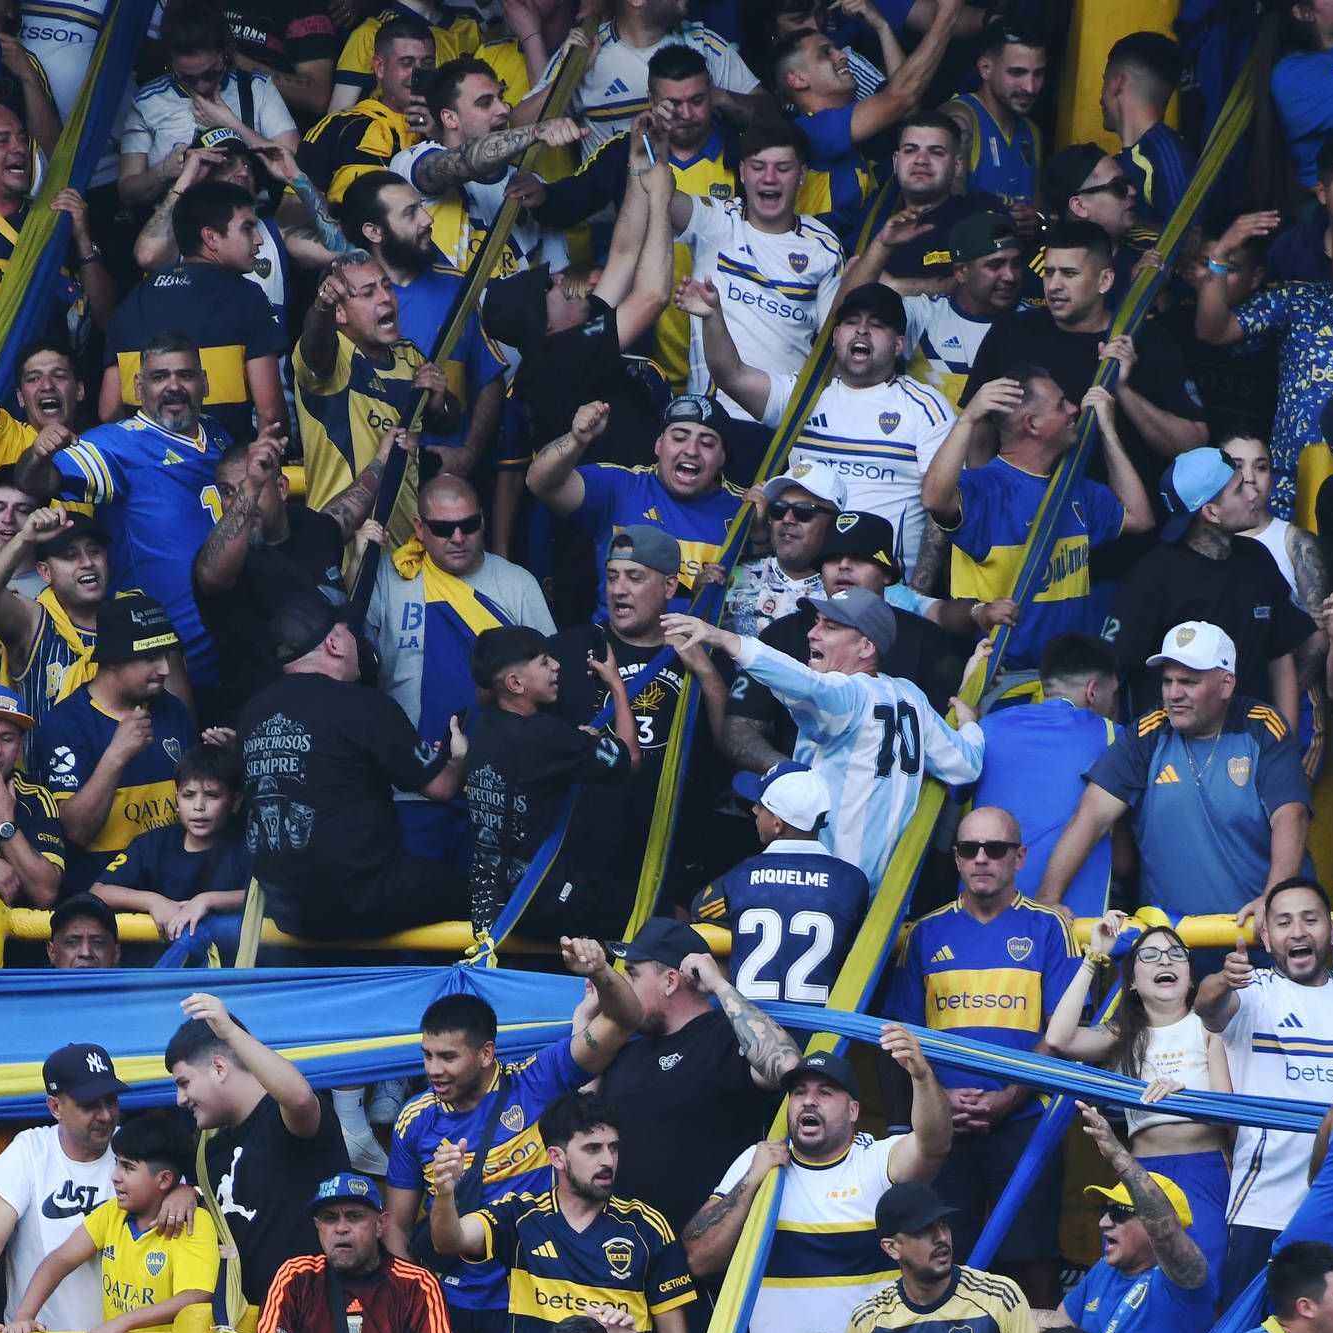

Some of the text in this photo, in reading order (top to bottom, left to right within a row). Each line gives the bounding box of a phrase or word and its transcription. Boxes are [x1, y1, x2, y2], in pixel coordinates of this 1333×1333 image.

[23, 26, 82, 43] tsson
[728, 283, 814, 325] betsson
[880, 418, 899, 426] CABJ
[807, 457, 895, 483] tsson
[266, 726, 282, 737] LOS
[873, 700, 921, 778] 10
[243, 735, 312, 755] OSPECHOSOS
[247, 757, 301, 776] SIEMPRE
[49, 774, 78, 785] AXION
[125, 800, 177, 824] QATA
[750, 868, 829, 888] RIQUELME
[737, 908, 835, 1003] 22
[1010, 944, 1030, 952] CABJ
[935, 990, 1027, 1013] betsson
[86, 1053, 108, 1074] NY
[483, 1141, 539, 1174] sson
[56, 1179, 99, 1209] JUST
[146, 1256, 164, 1265] CABJ
[103, 1274, 155, 1305] QATAR
